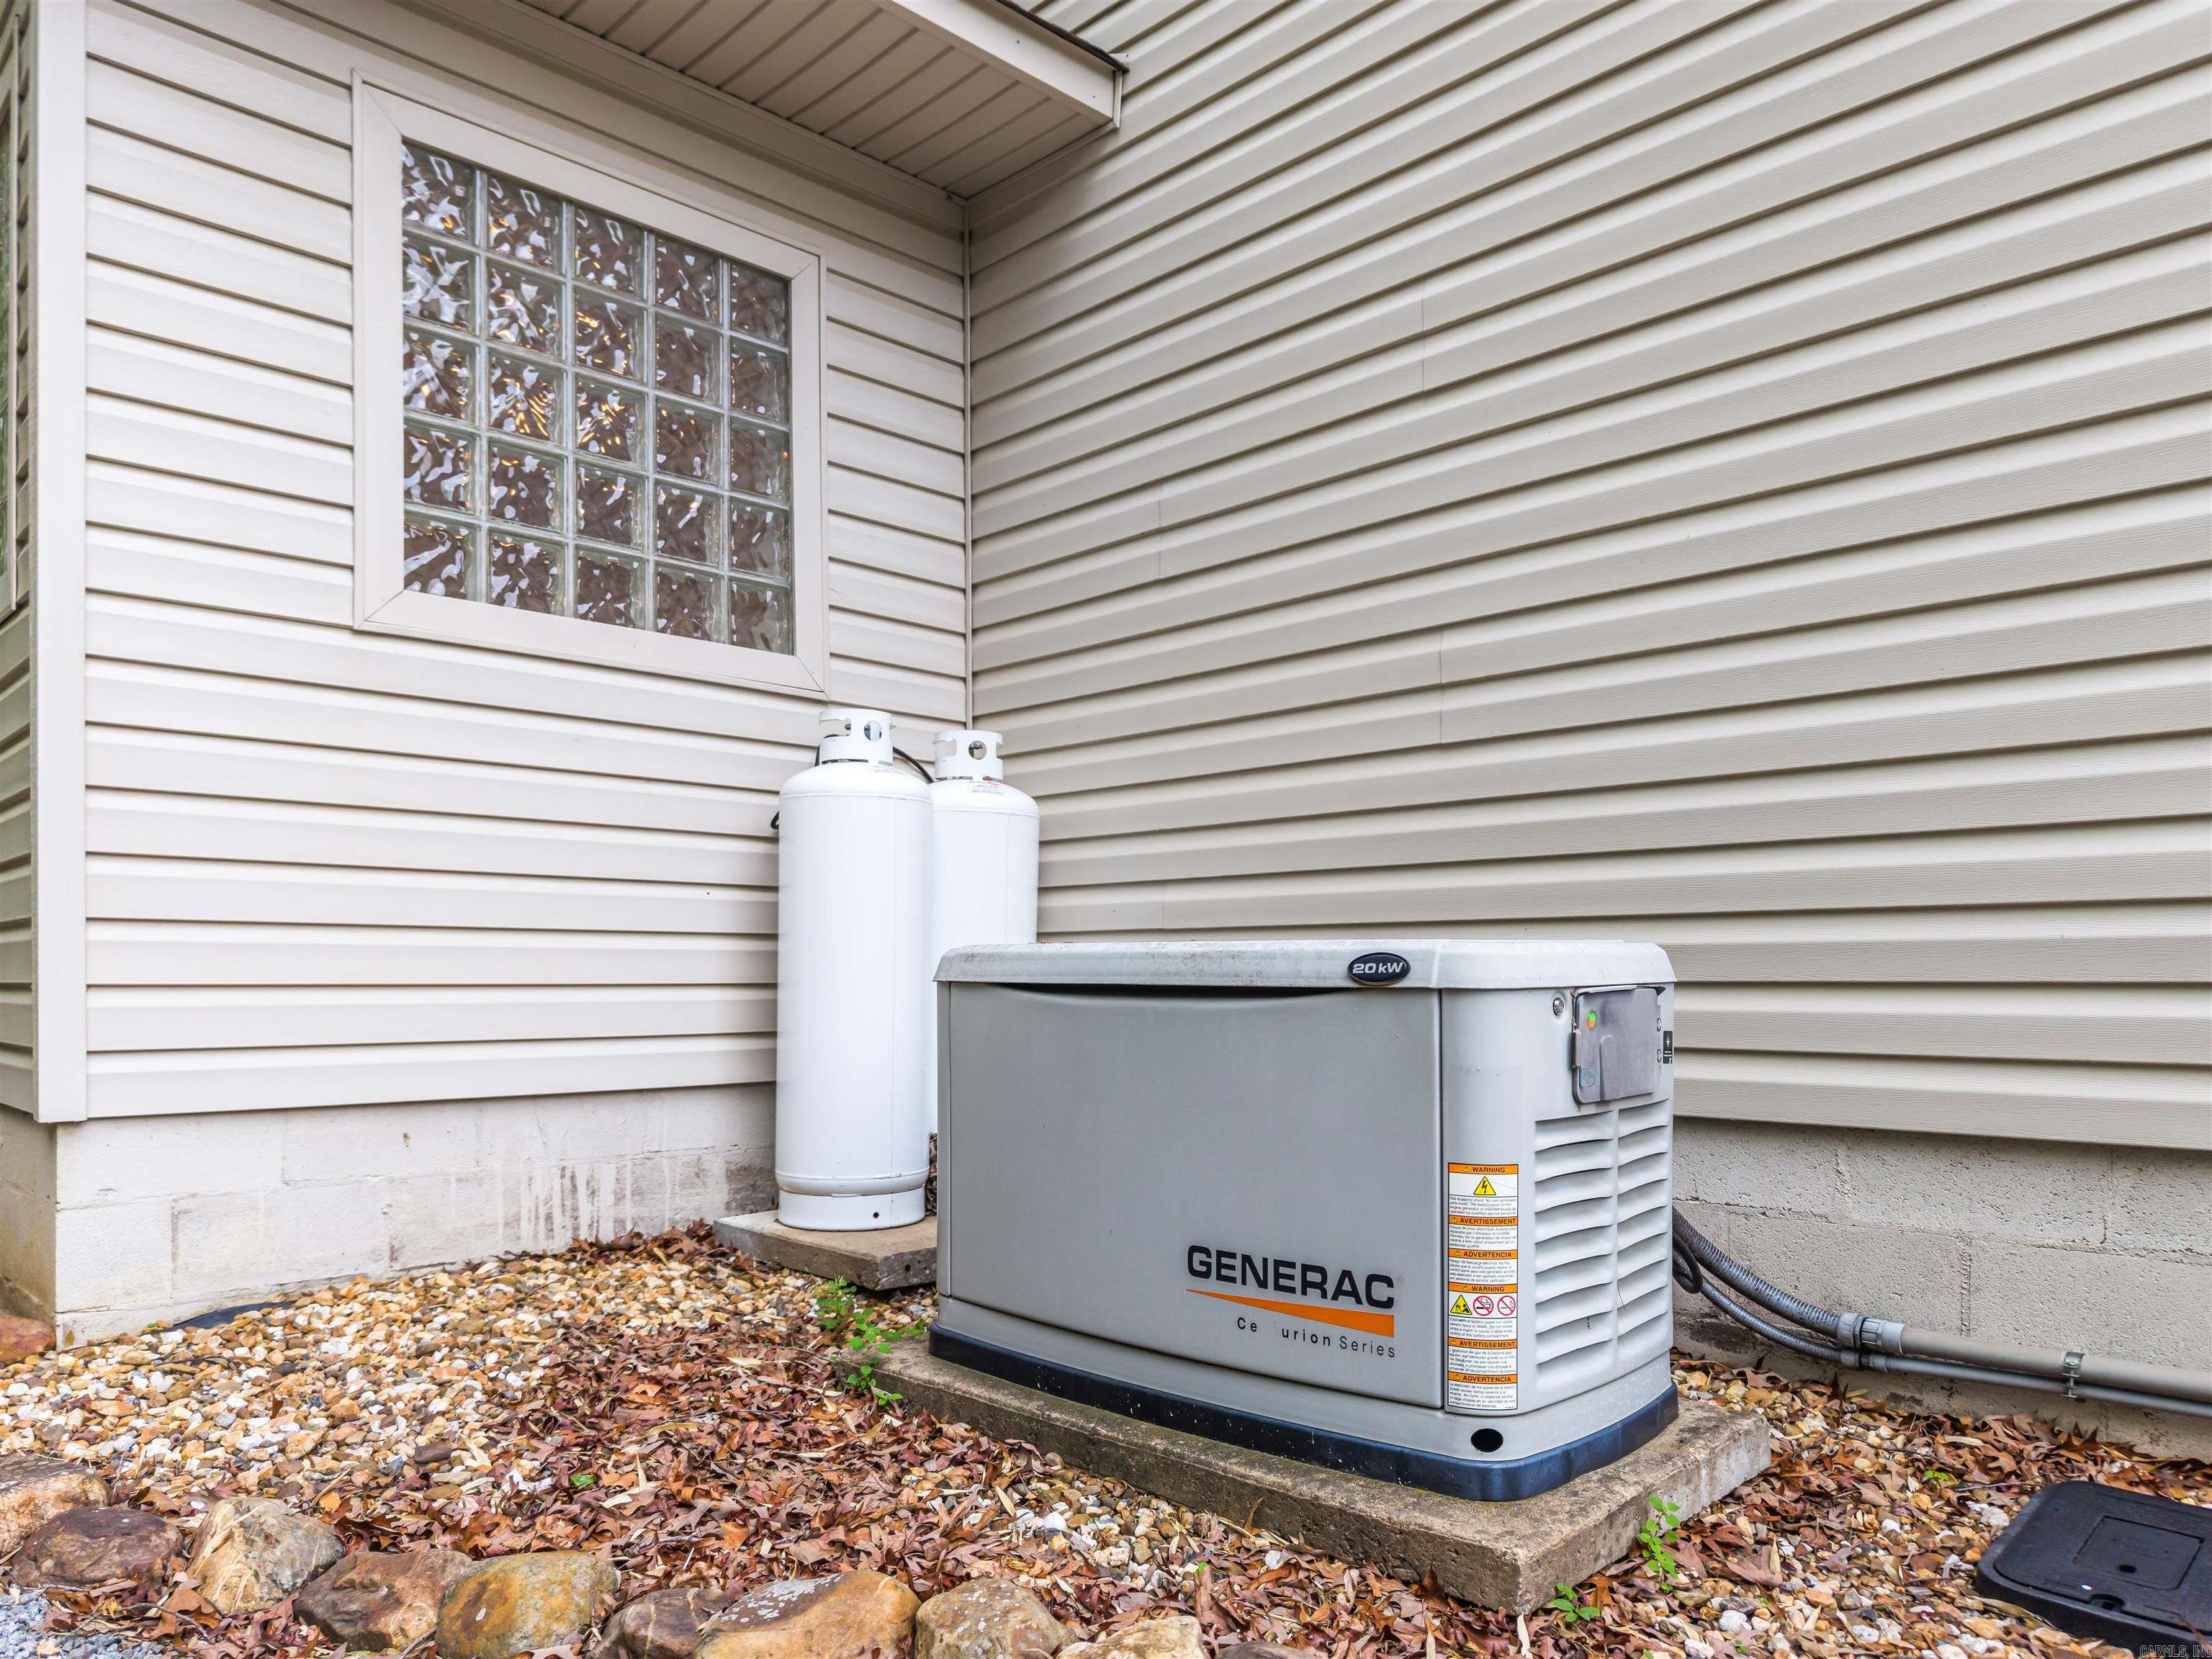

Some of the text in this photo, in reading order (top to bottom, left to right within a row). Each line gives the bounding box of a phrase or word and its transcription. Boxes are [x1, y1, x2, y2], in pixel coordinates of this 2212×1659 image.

[1353, 962, 1403, 974] 20 kW
[1187, 1245, 1395, 1309] GENERAC
[1237, 1317, 1395, 1358] Ceurion Series
